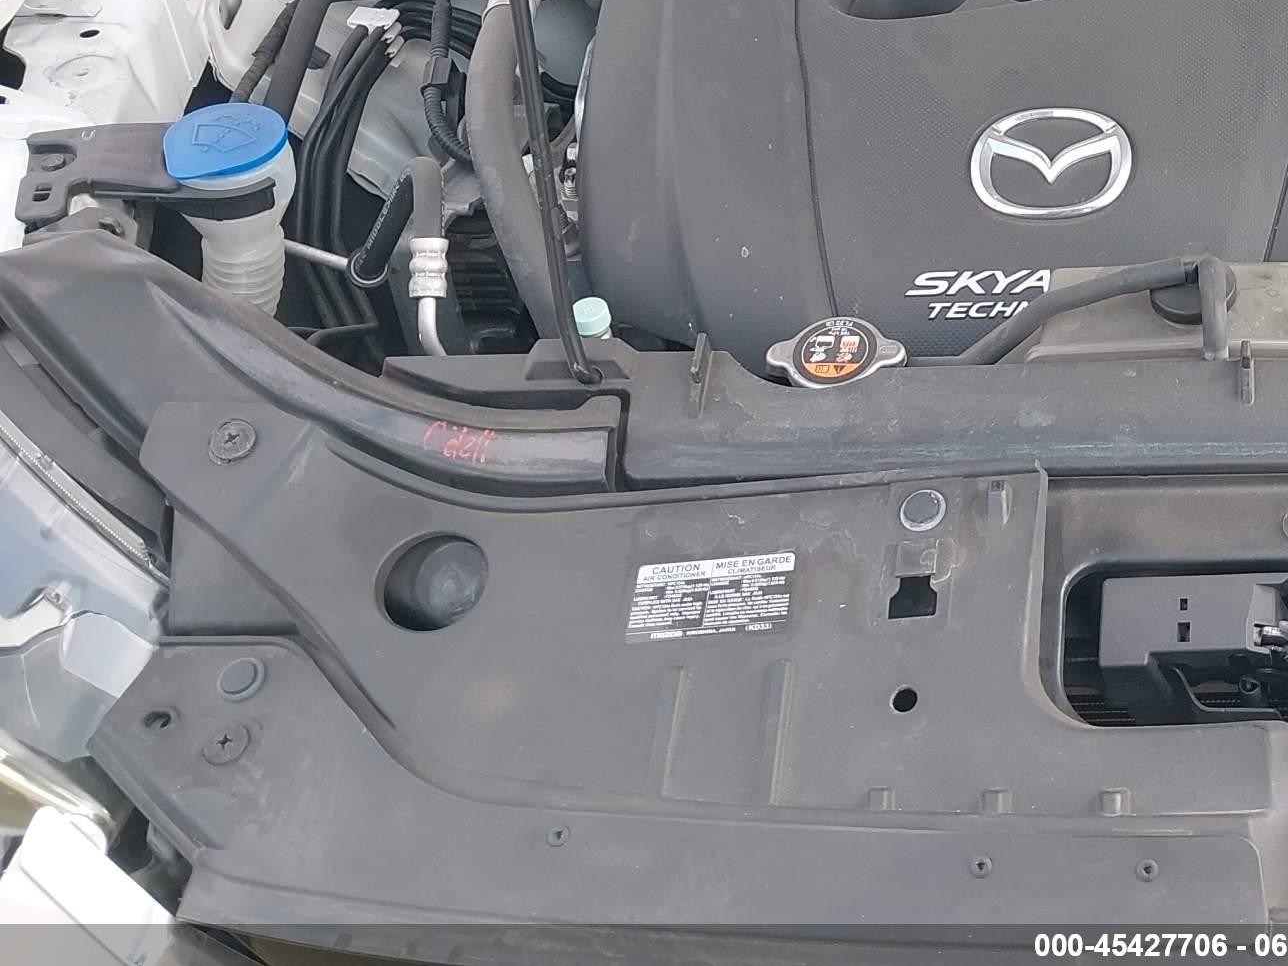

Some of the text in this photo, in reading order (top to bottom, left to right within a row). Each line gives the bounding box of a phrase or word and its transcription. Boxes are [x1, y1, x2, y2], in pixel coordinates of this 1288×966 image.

[715, 555, 792, 569] MISE EN GARDE
[652, 563, 701, 575] CAUTION
[727, 565, 776, 575] CLIMATISEUR
[656, 571, 706, 581] CONDITIONER
